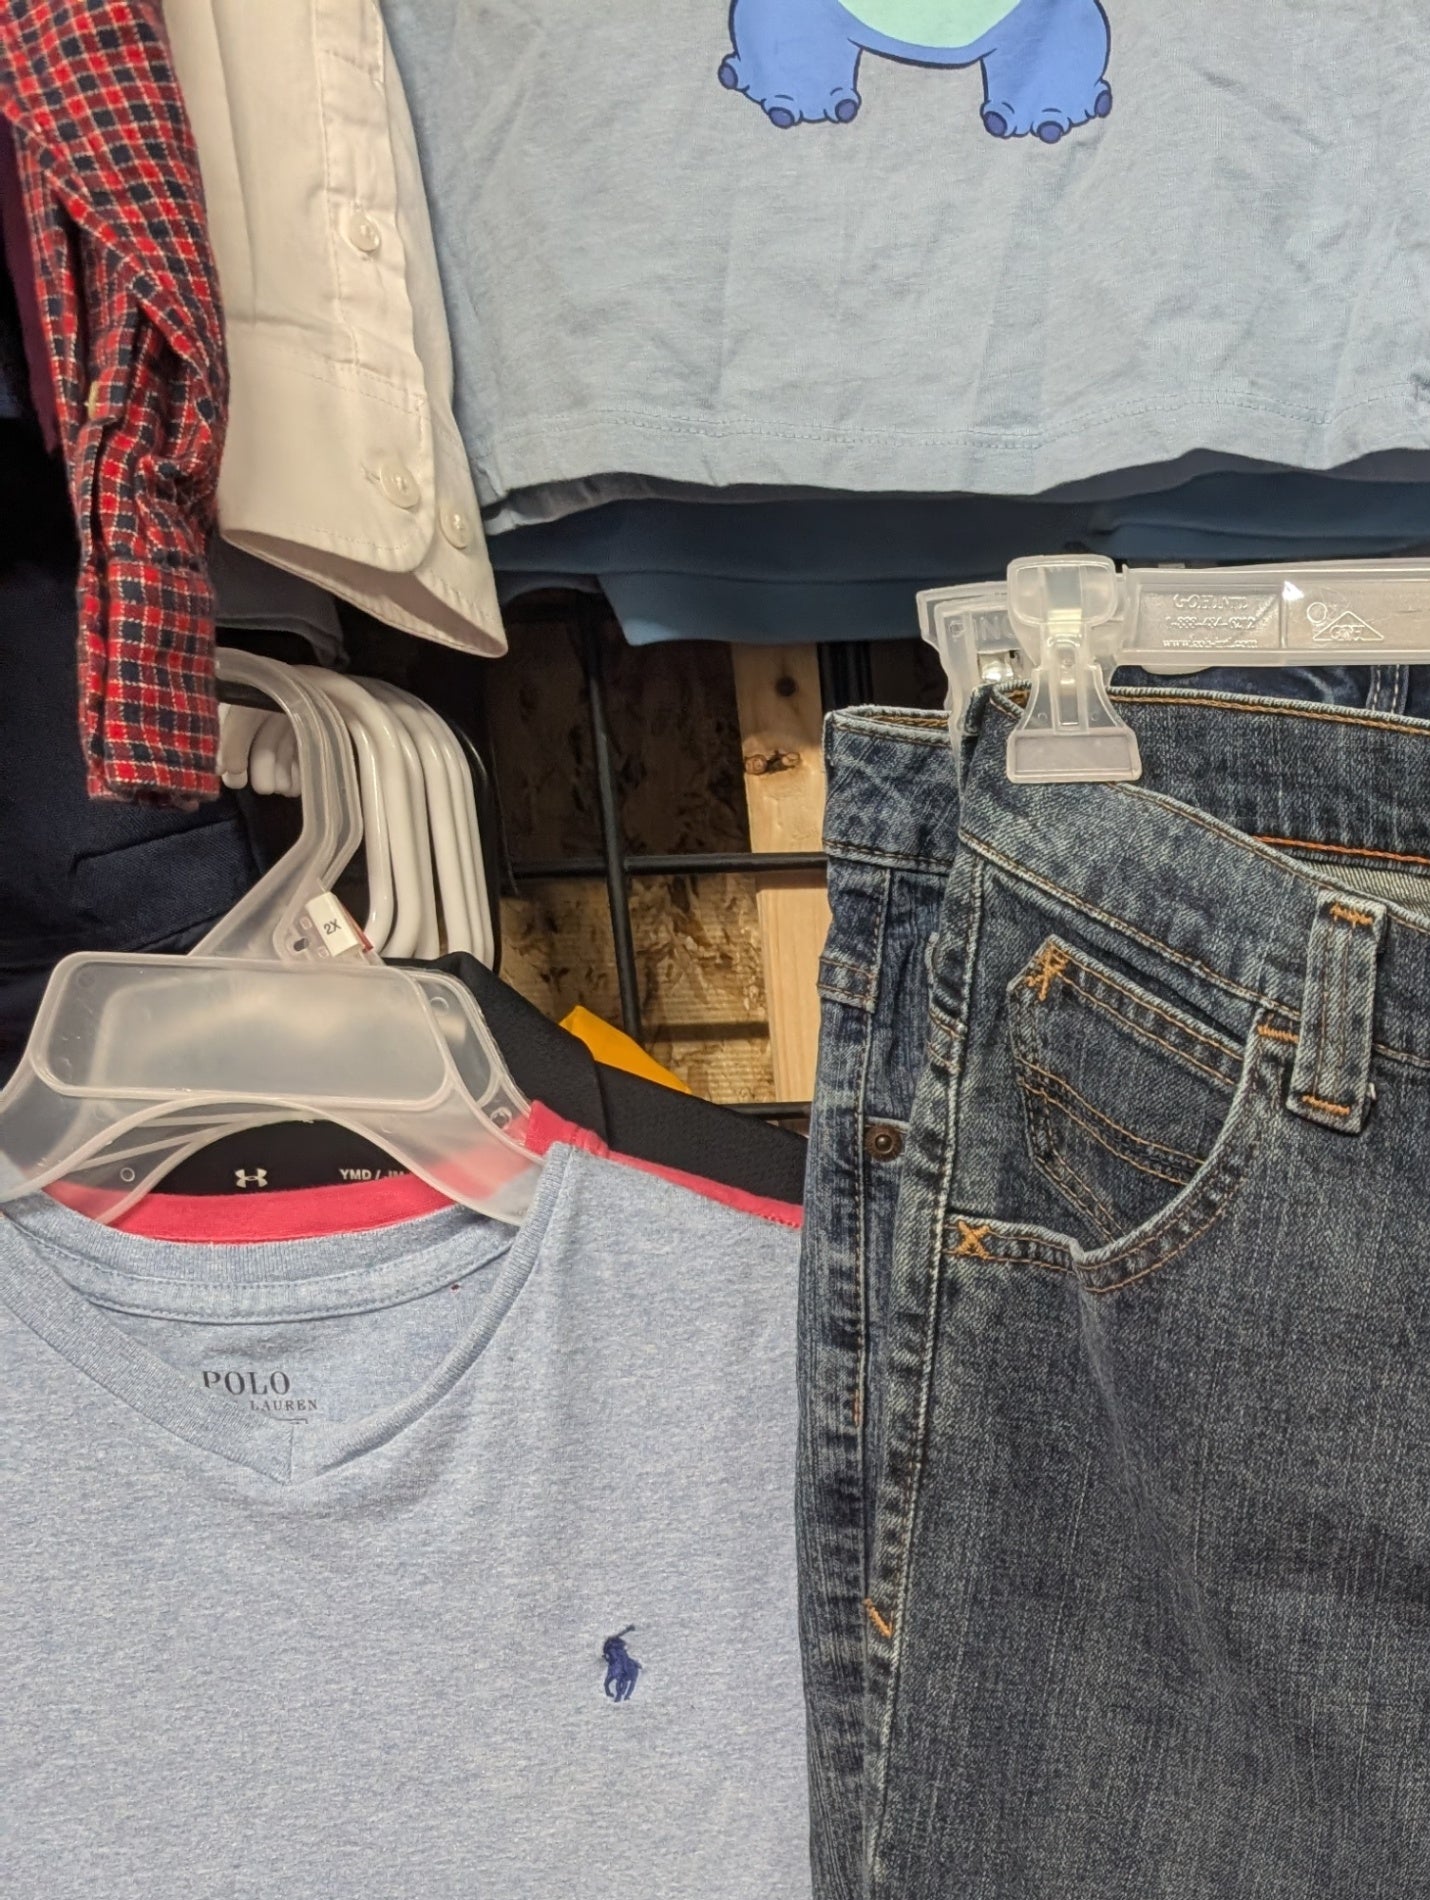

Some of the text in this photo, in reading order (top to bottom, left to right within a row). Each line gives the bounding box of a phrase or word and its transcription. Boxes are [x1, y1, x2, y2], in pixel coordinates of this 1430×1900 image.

[323, 918, 342, 935] 2X
[339, 1168, 372, 1180] YMD
[202, 1370, 290, 1395] POLO
[249, 1399, 318, 1411] LAUREN
